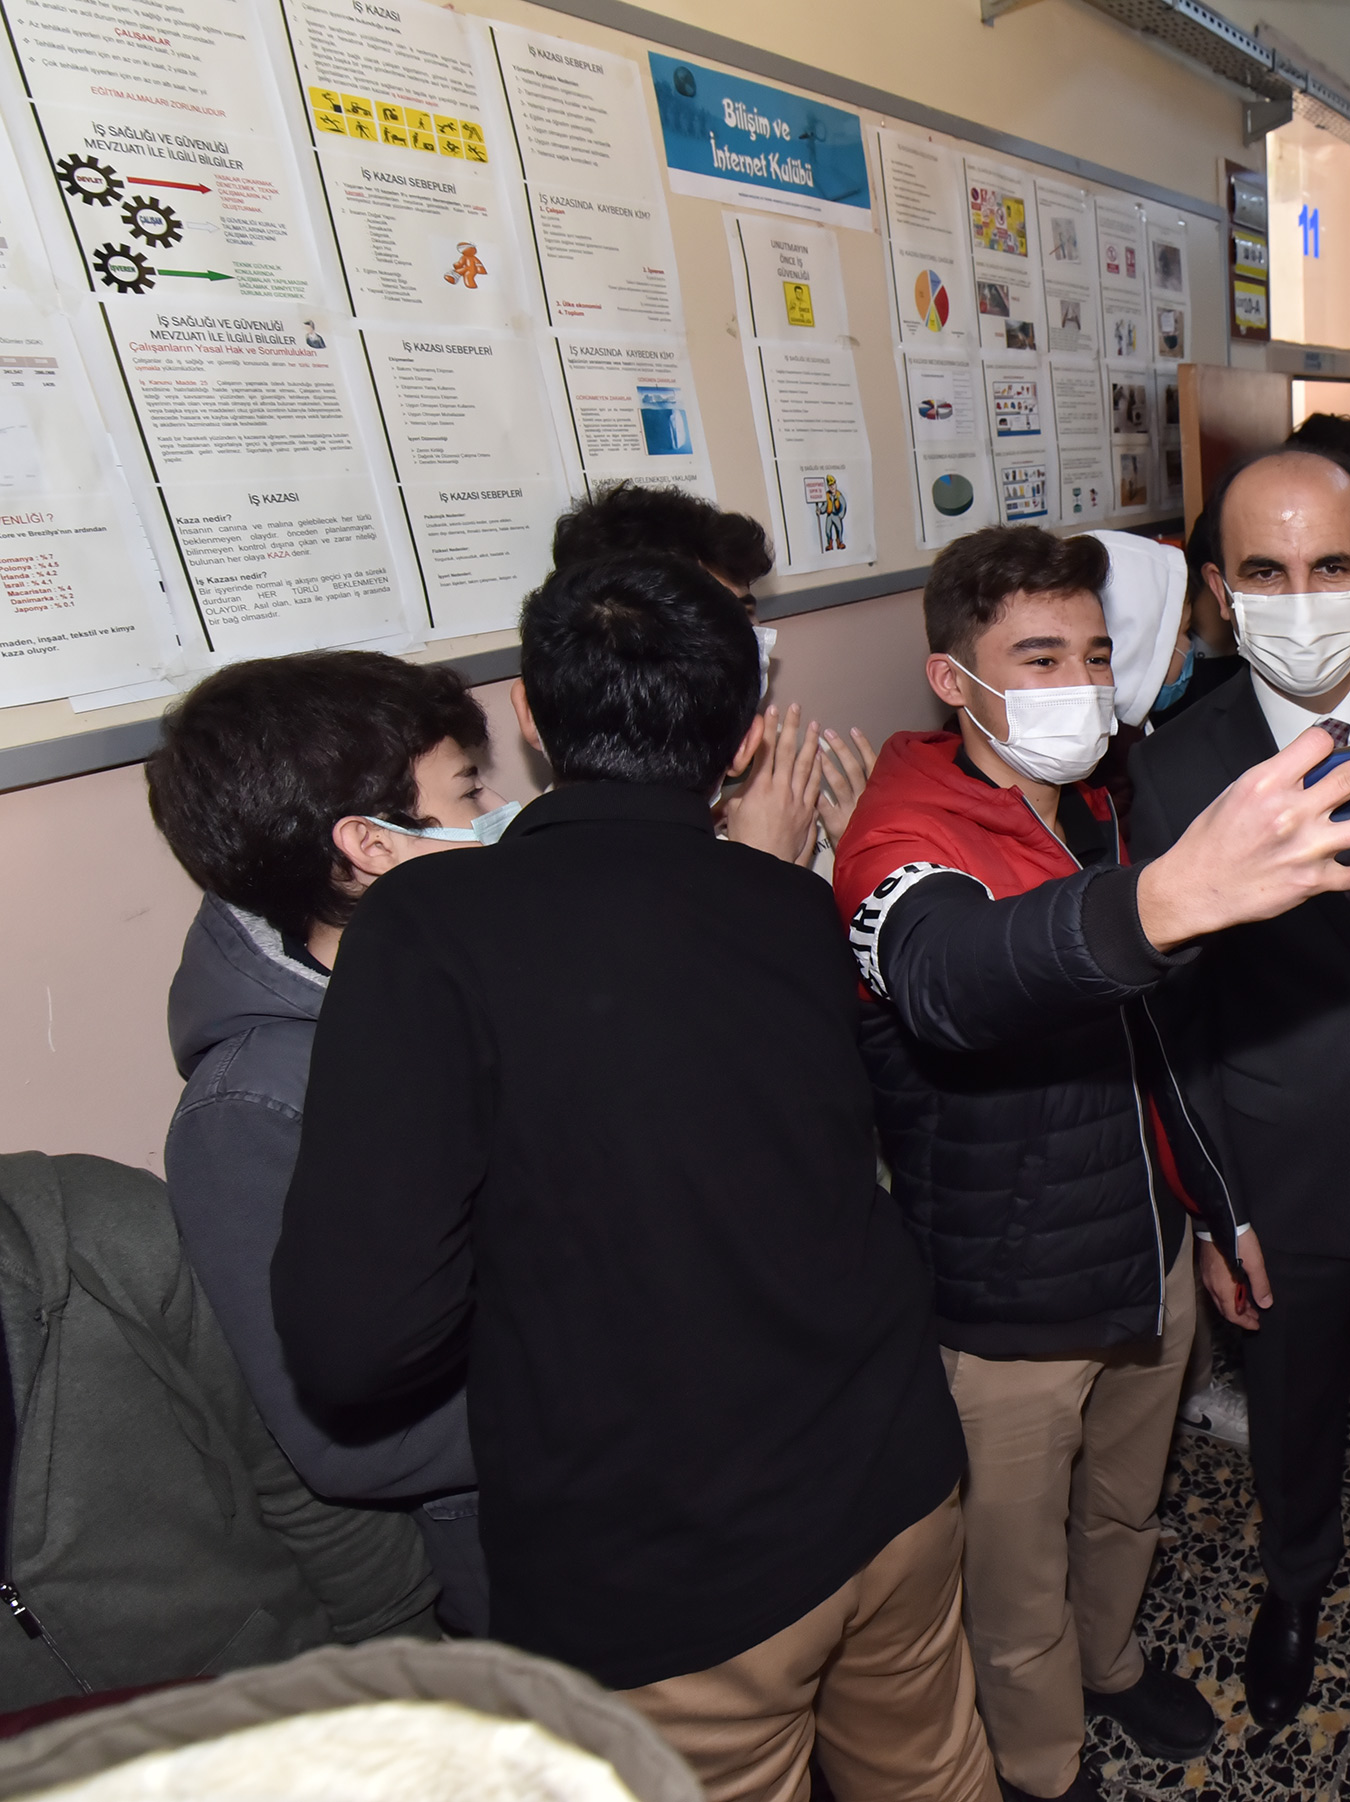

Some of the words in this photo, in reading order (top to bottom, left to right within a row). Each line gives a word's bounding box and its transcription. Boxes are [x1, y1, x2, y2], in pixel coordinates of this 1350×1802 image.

[365, 3, 401, 23] KAZASI
[114, 27, 171, 46] ÇALIŞANLAR
[537, 48, 563, 63] KAZASI
[90, 86, 125, 98] EĞİTİM
[126, 92, 169, 107] ALMALARI
[722, 98, 770, 141] Bilişim
[773, 118, 791, 141] ve
[91, 120, 106, 137] İŞ
[108, 125, 157, 142] SAĞLIĞI
[157, 133, 173, 145] VE
[174, 135, 229, 155] GÜVENLİĞİ
[84, 137, 146, 156] MEVZUATI
[147, 144, 166, 158] İLE
[167, 148, 196, 164] İLGİLİ
[198, 154, 244, 171] BİLGİLER
[710, 131, 767, 178] İnternet
[768, 152, 814, 188] Kulübü
[360, 166, 372, 182] İŞ
[373, 170, 407, 185] KAZASI
[408, 177, 457, 195] SEBEPLERİ
[539, 192, 547, 204] İŞ
[550, 195, 594, 210] KAZASINDA
[597, 203, 634, 218] KAYBEDEN
[1298, 204, 1319, 259] 11
[770, 240, 809, 254] UNUTMAYIN
[157, 313, 169, 328] İŞ
[172, 314, 217, 328] SAĞLIĞI
[218, 318, 232, 329] VE
[233, 317, 284, 332] GÜVENLİĞİ
[150, 329, 205, 342] MEVZUATI
[209, 330, 224, 342] İLE
[225, 331, 253, 344] İLGİLİ
[255, 332, 297, 346] BİLGİLER
[129, 341, 193, 354] Çalışanların
[194, 344, 223, 354] Yasal
[225, 345, 245, 354] Hak
[402, 339, 412, 353] İŞ
[413, 342, 445, 352] KAZASI
[445, 344, 493, 355] SEBEPLERİ
[569, 344, 578, 356] İŞ
[580, 347, 622, 357] KAZASINDA
[626, 350, 659, 359] KAYBEDEN
[248, 493, 261, 507] İŞ
[262, 492, 300, 504] KAZASI
[439, 491, 448, 503] İŞ
[449, 492, 480, 501] KAZASI
[481, 487, 523, 500] SEBEPLERİ
[176, 516, 200, 525] Kaza
[202, 514, 232, 523] nedir?
[218, 524, 248, 533] canına
[268, 520, 293, 529] malına
[341, 515, 353, 523] her
[182, 536, 241, 546] beklenmeyen
[286, 529, 318, 537] önceden
[186, 546, 234, 556] bilinmeyen
[238, 544, 266, 552] kontrol
[298, 538, 318, 548] çıkan
[334, 535, 352, 543] zarar
[0, 556, 34, 564] omanya
[189, 558, 225, 567] bulunan
[227, 555, 241, 563] her
[244, 553, 265, 562] olaya
[195, 576, 205, 586] İş
[206, 576, 238, 585] Kazası
[240, 571, 267, 581] nedir?
[198, 587, 211, 595] Bir
[214, 584, 253, 595] işyerinde
[256, 580, 283, 589] normal
[343, 572, 352, 580] ya
[7, 587, 52, 597] Macaristan
[10, 595, 55, 605] Danimarka
[202, 595, 242, 606] durduran
[257, 591, 278, 599] HER
[292, 585, 319, 595] TÜRLÜ
[332, 577, 388, 590] BEKLENMEYEN
[253, 602, 269, 610] Asıl
[325, 591, 351, 601] yapılan
[362, 586, 391, 595] arasında
[14, 604, 48, 613] Japonya
[208, 617, 220, 626] bir
[222, 614, 239, 624] bağ
[70, 629, 97, 638] tekstil
[111, 624, 135, 633] kimya
[1, 650, 25, 658] kaza
